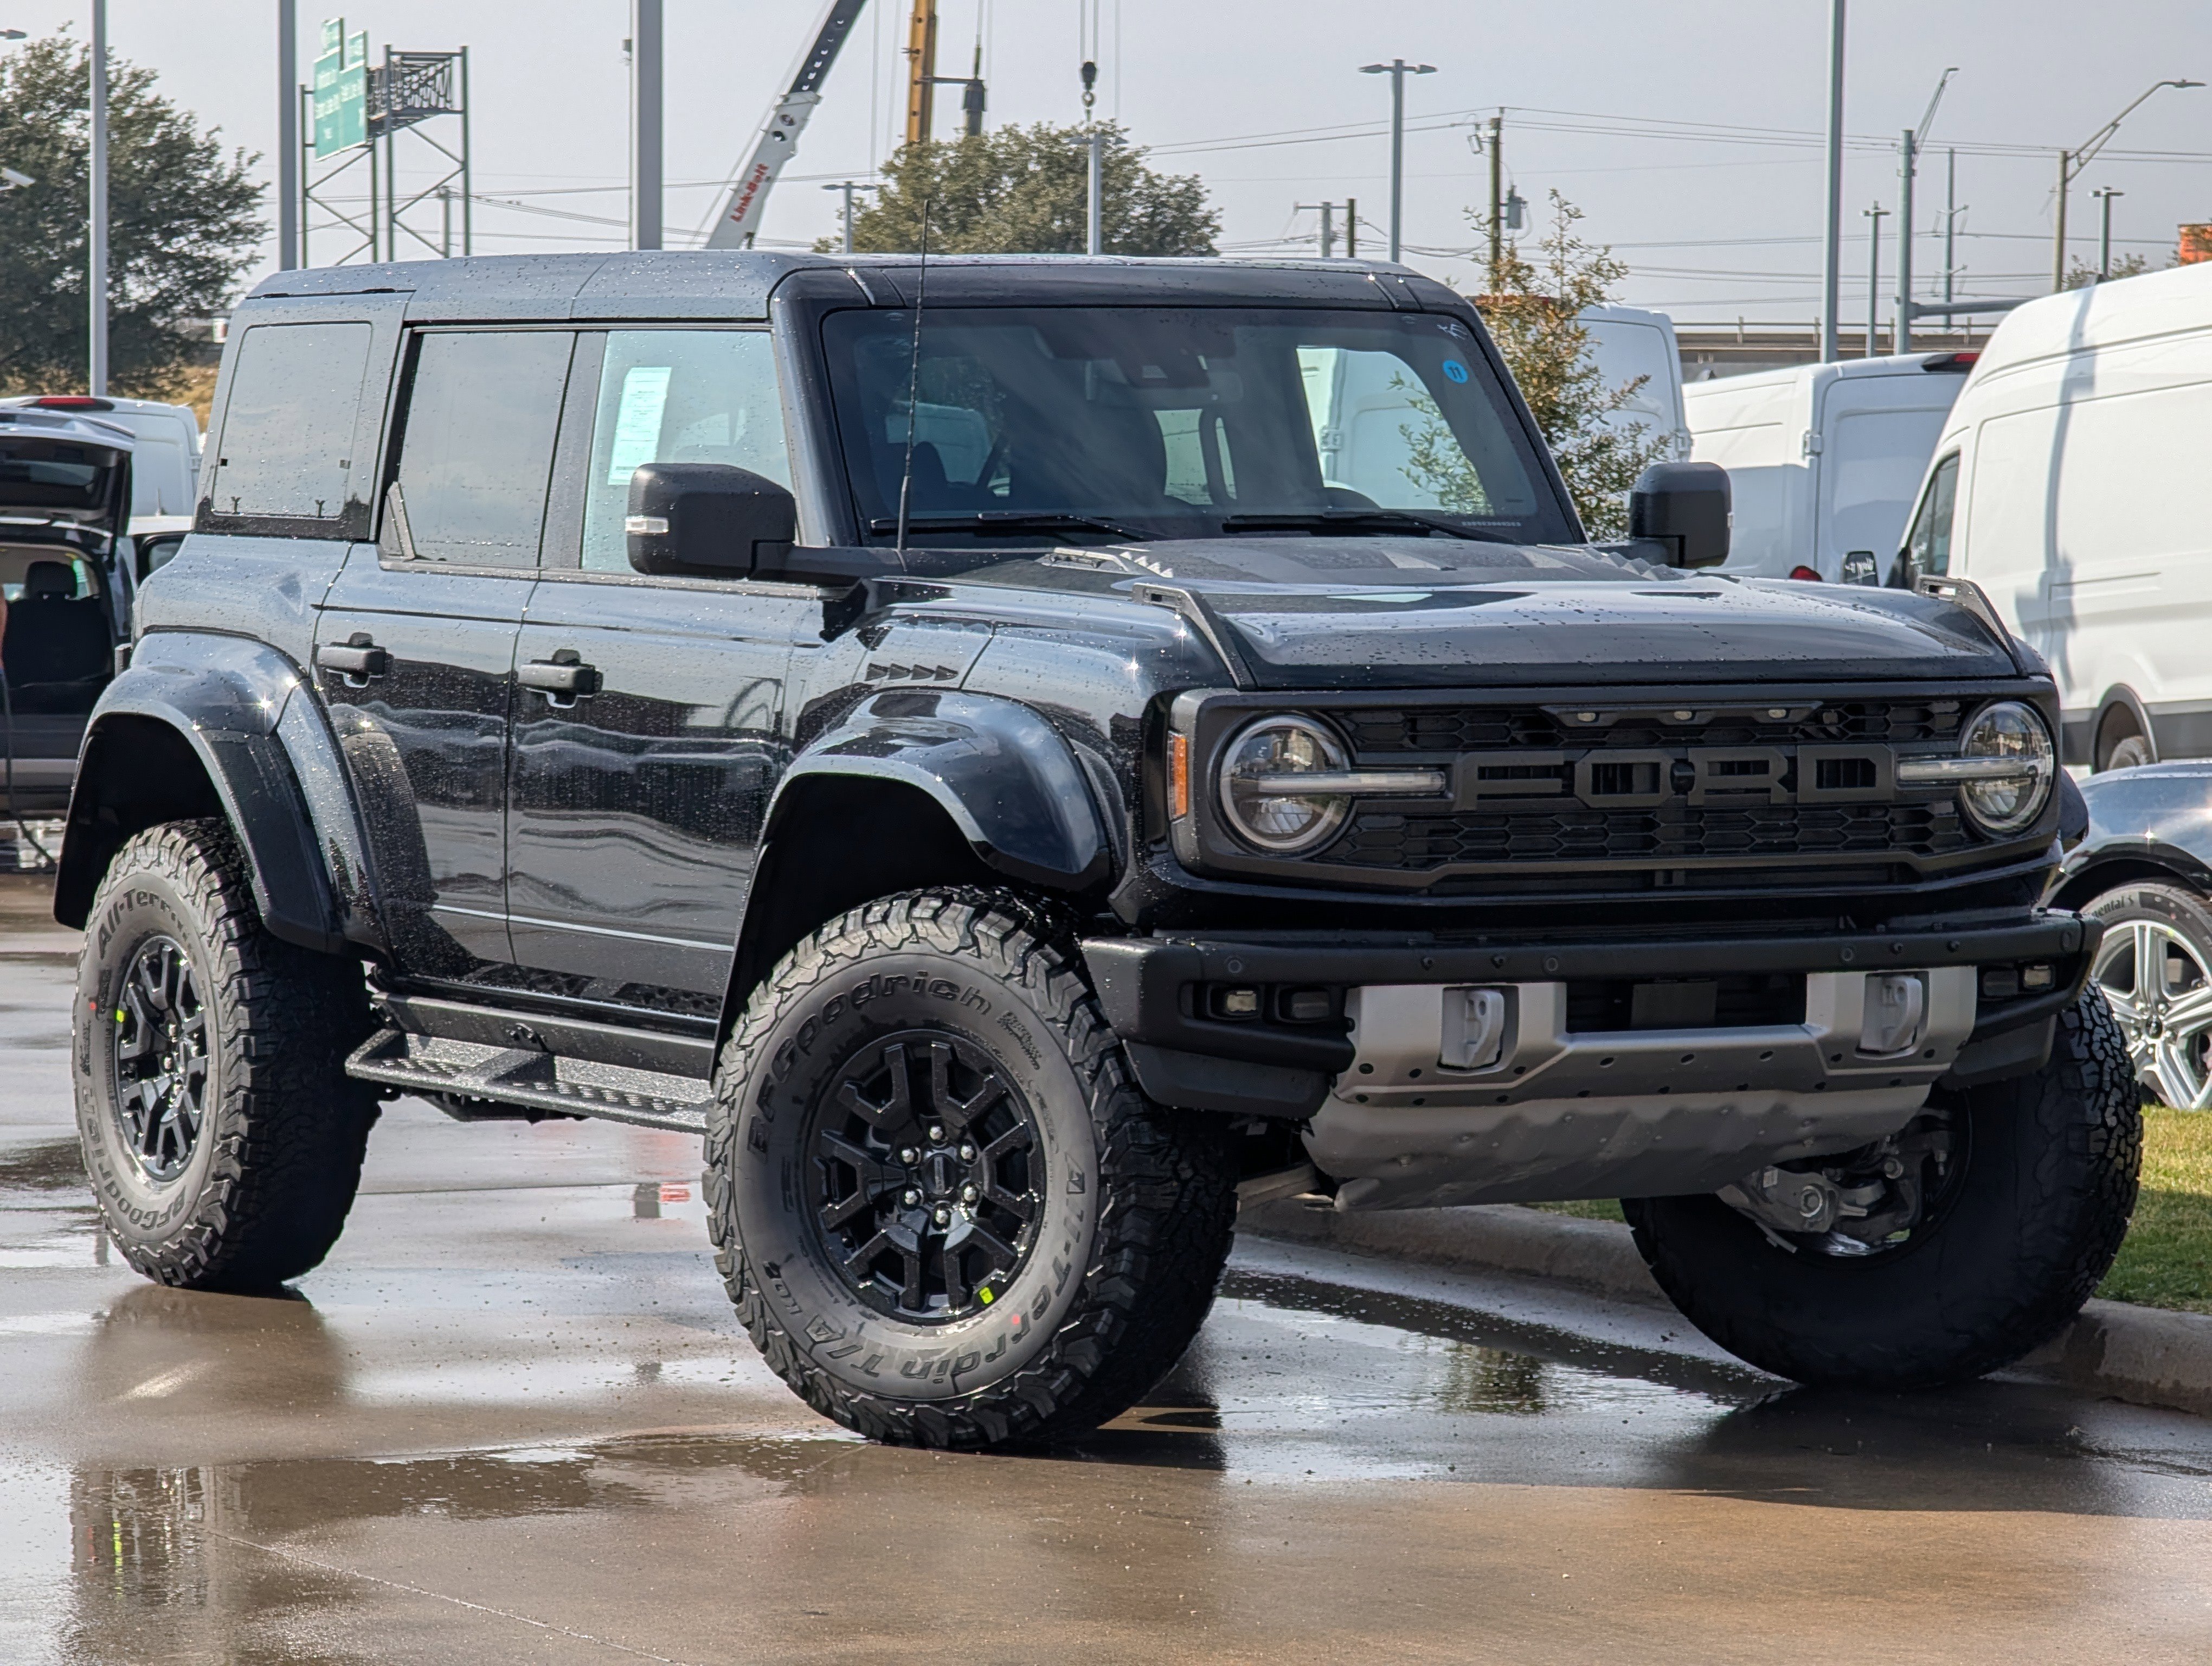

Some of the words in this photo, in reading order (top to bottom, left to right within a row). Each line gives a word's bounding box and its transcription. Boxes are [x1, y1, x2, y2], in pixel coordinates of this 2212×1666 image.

[1452, 744, 1895, 811] FORD
[747, 970, 993, 1155] BFGoodrich
[81, 1085, 187, 1231] BFGoodrich
[899, 1151, 1086, 1385] All-Terrain
